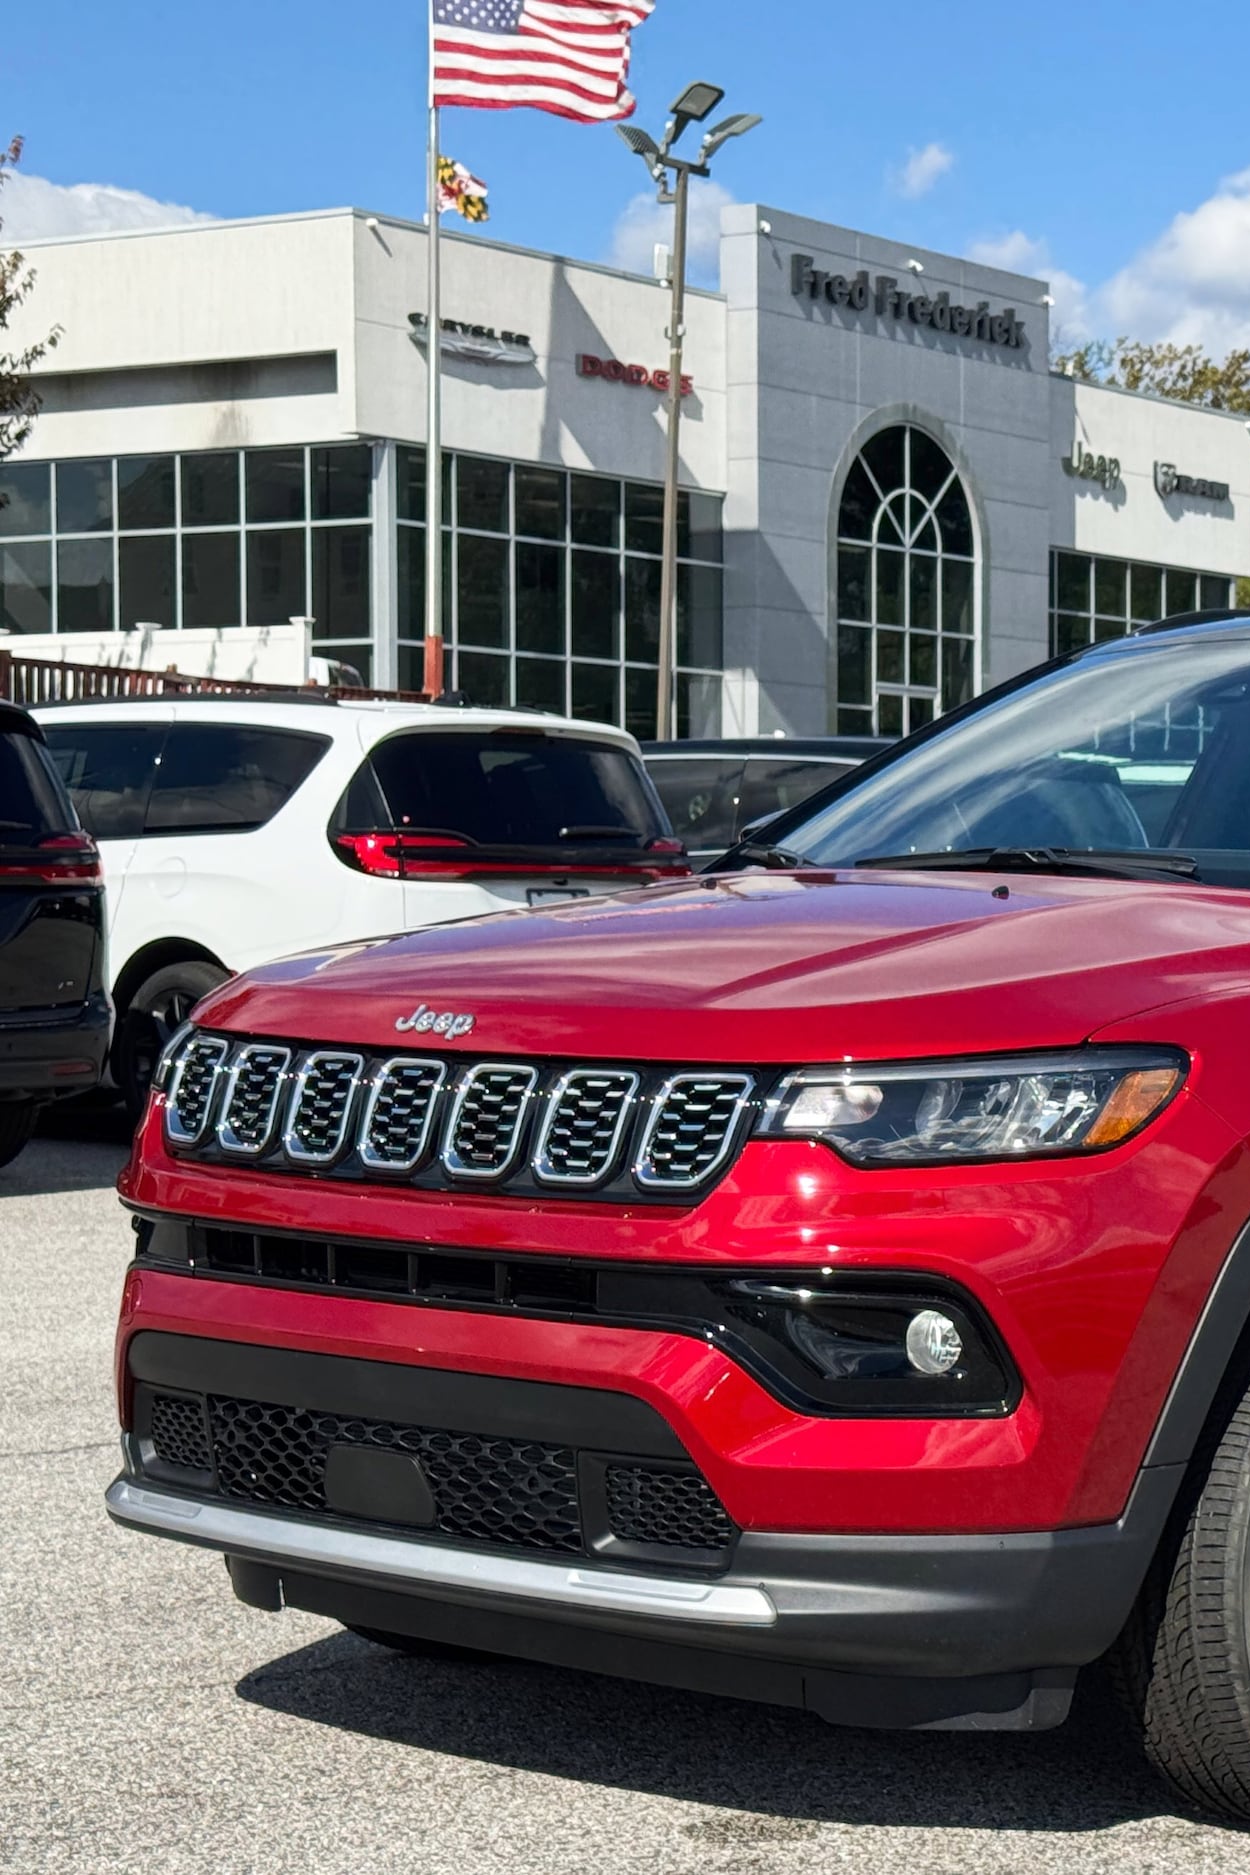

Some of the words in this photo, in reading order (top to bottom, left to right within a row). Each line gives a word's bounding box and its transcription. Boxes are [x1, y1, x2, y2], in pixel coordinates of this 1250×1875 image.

[791, 253, 869, 311] Fred
[875, 275, 1026, 348] Frederick
[1062, 441, 1121, 490] Jeep
[395, 1003, 475, 1041] Jeep
